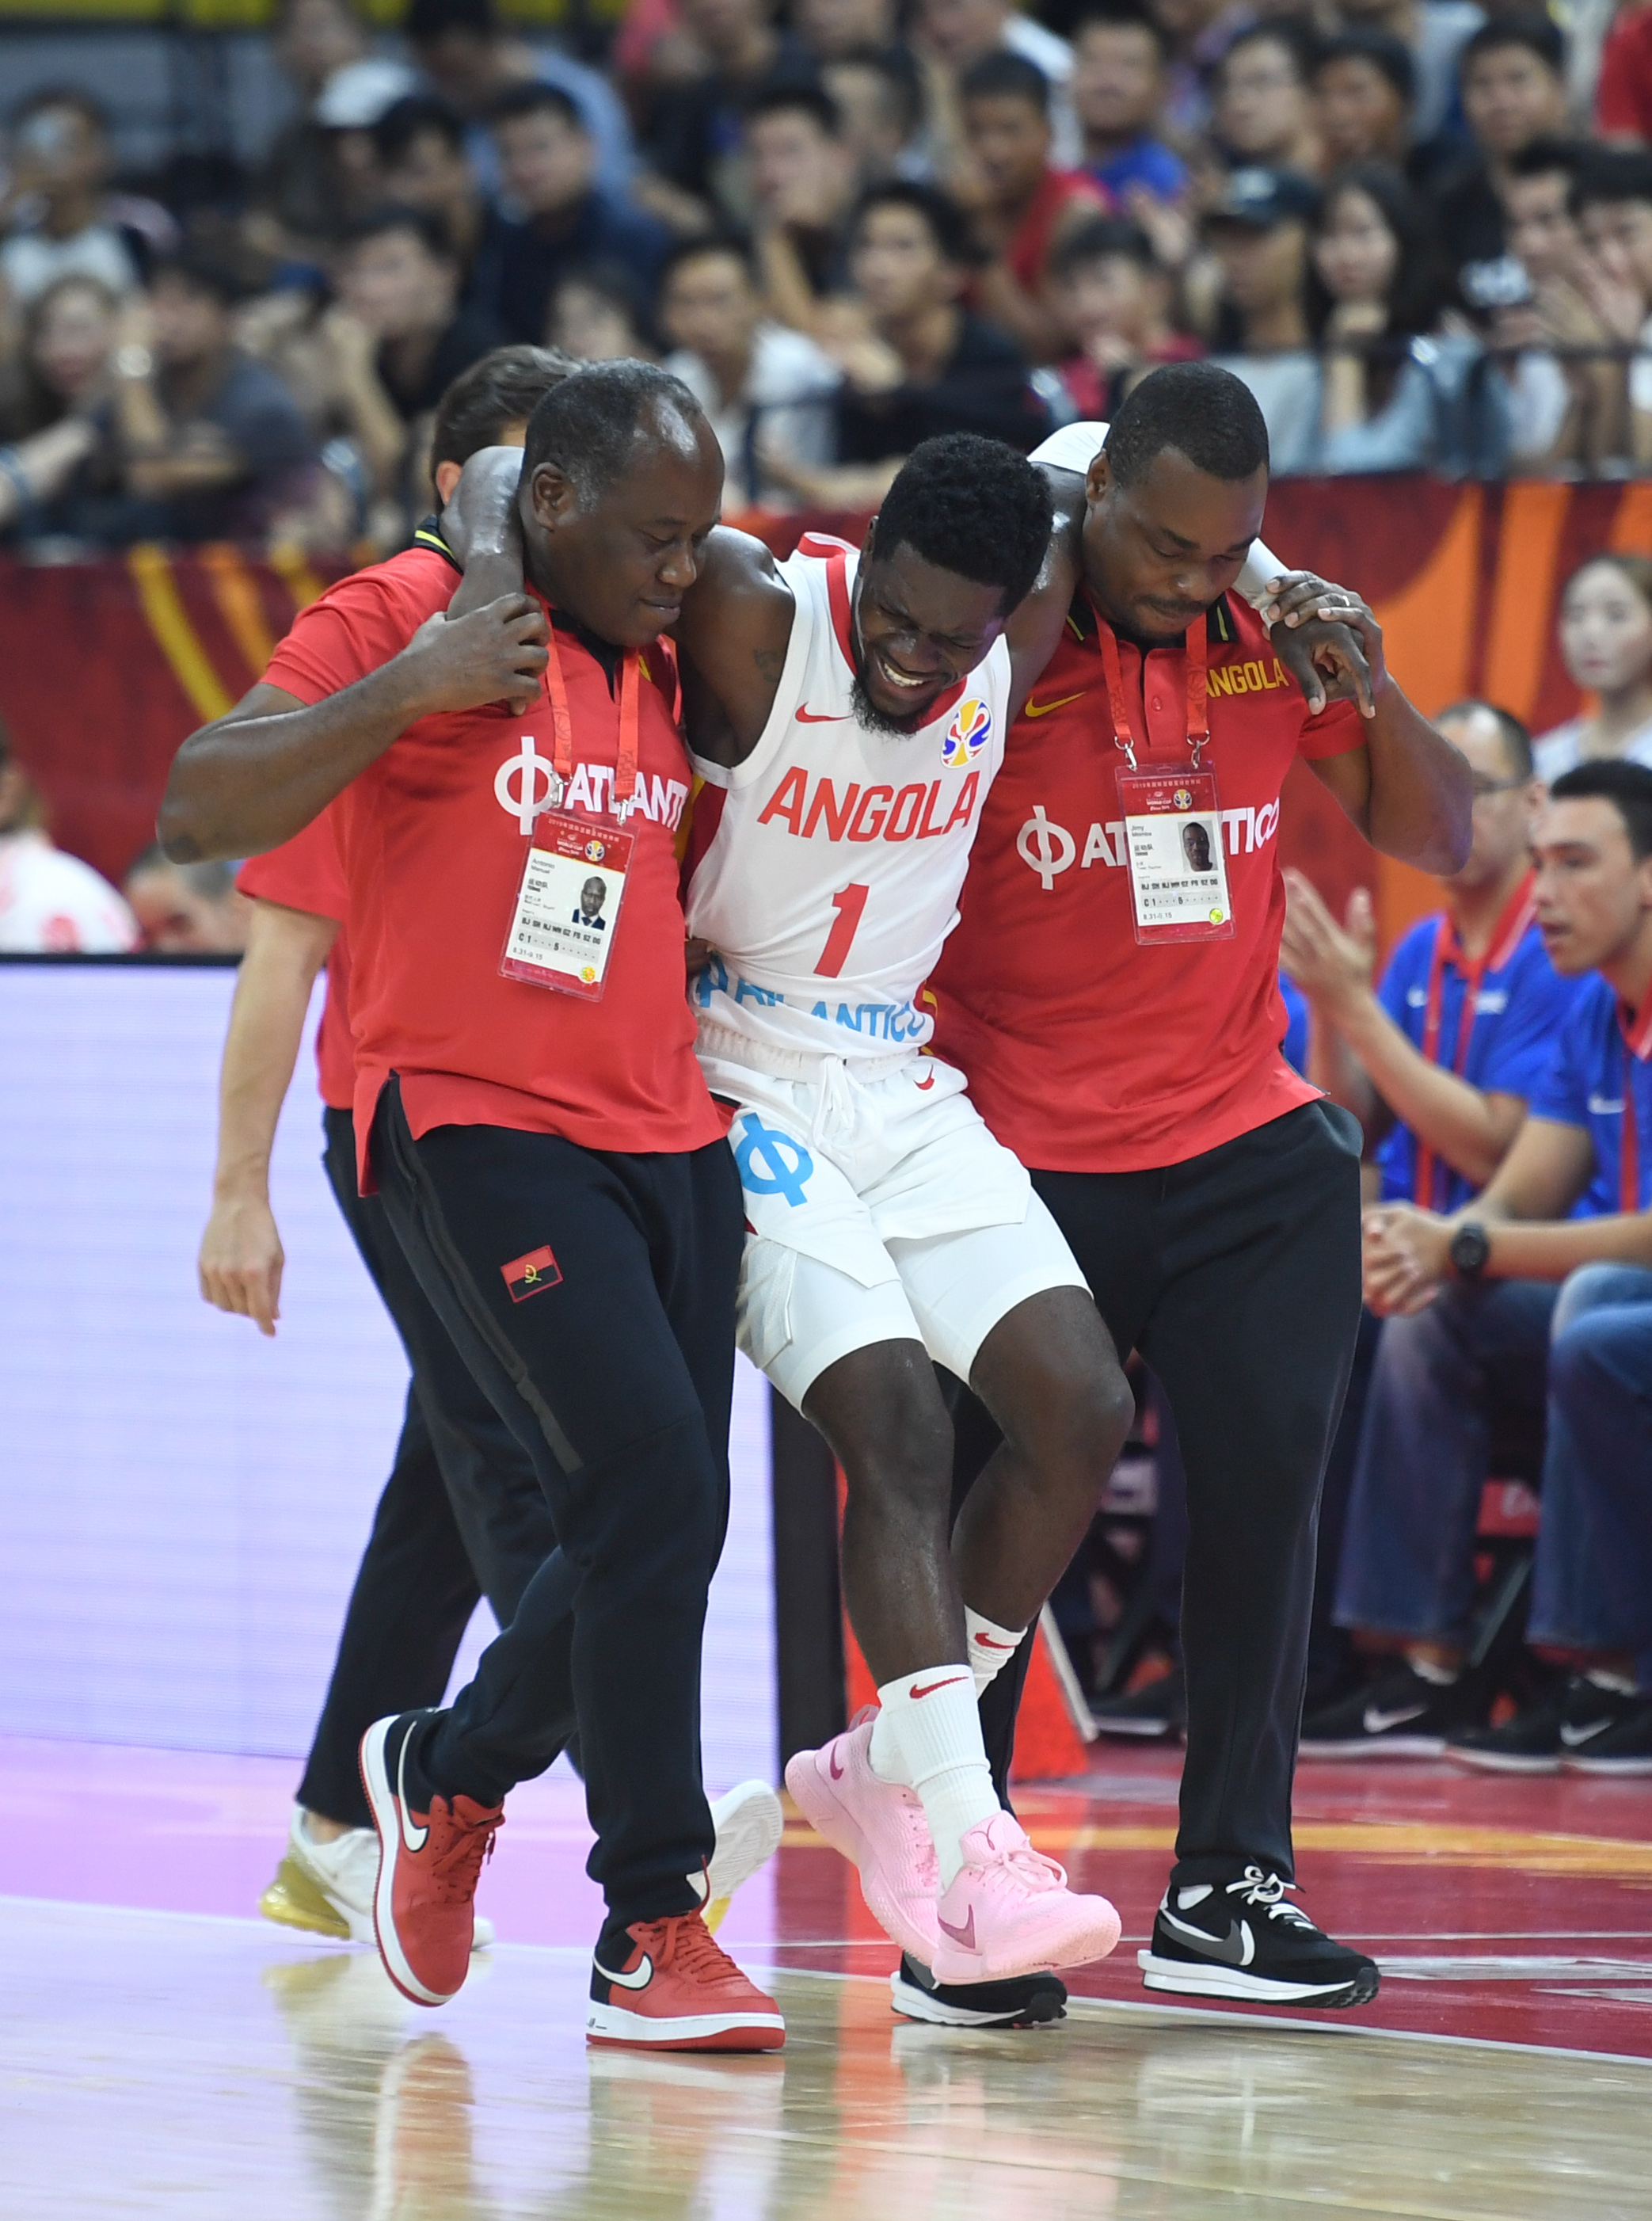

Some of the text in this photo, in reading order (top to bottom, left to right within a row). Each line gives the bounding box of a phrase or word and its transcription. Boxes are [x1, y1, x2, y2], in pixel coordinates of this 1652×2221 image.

[756, 765, 980, 843] ANGOLA
[1144, 898, 1149, 907] C
[519, 932, 524, 942] C
[813, 882, 870, 979] 1
